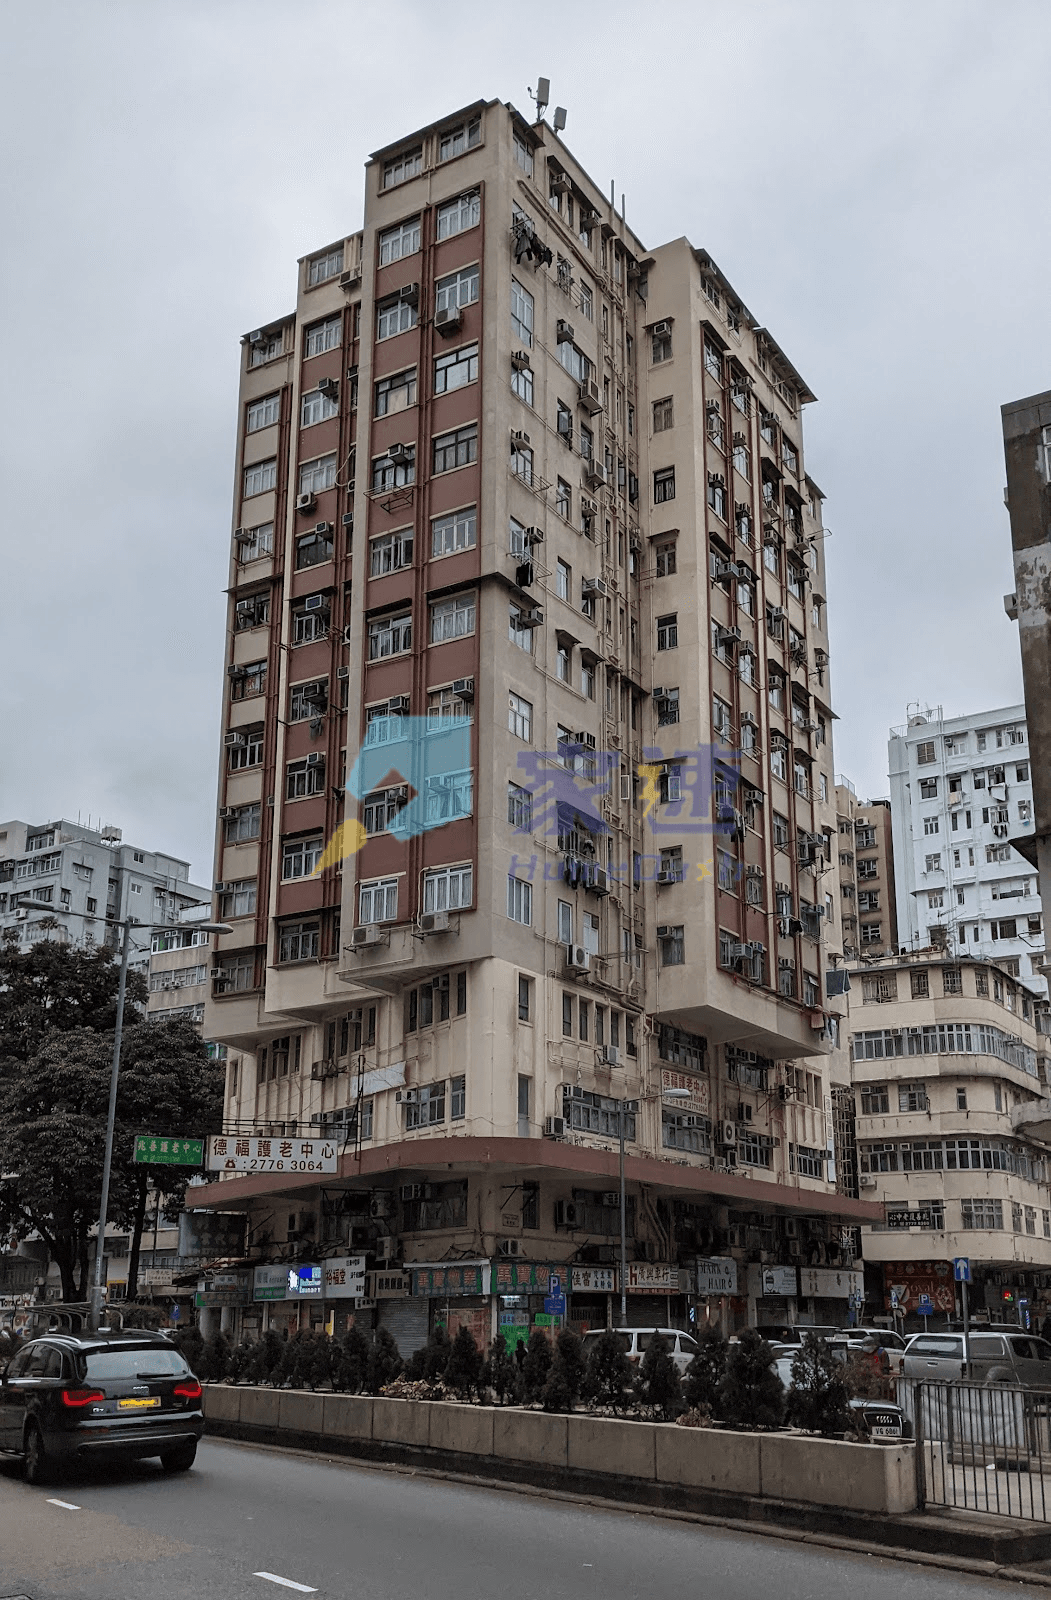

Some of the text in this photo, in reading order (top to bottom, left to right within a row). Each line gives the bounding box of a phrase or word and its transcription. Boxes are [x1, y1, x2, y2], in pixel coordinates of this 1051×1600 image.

[213, 1138, 335, 1159] 德福護老中心
[290, 1160, 324, 1171] 3064
[708, 1278, 726, 1290] HAIR
[920, 1294, 928, 1304] P
